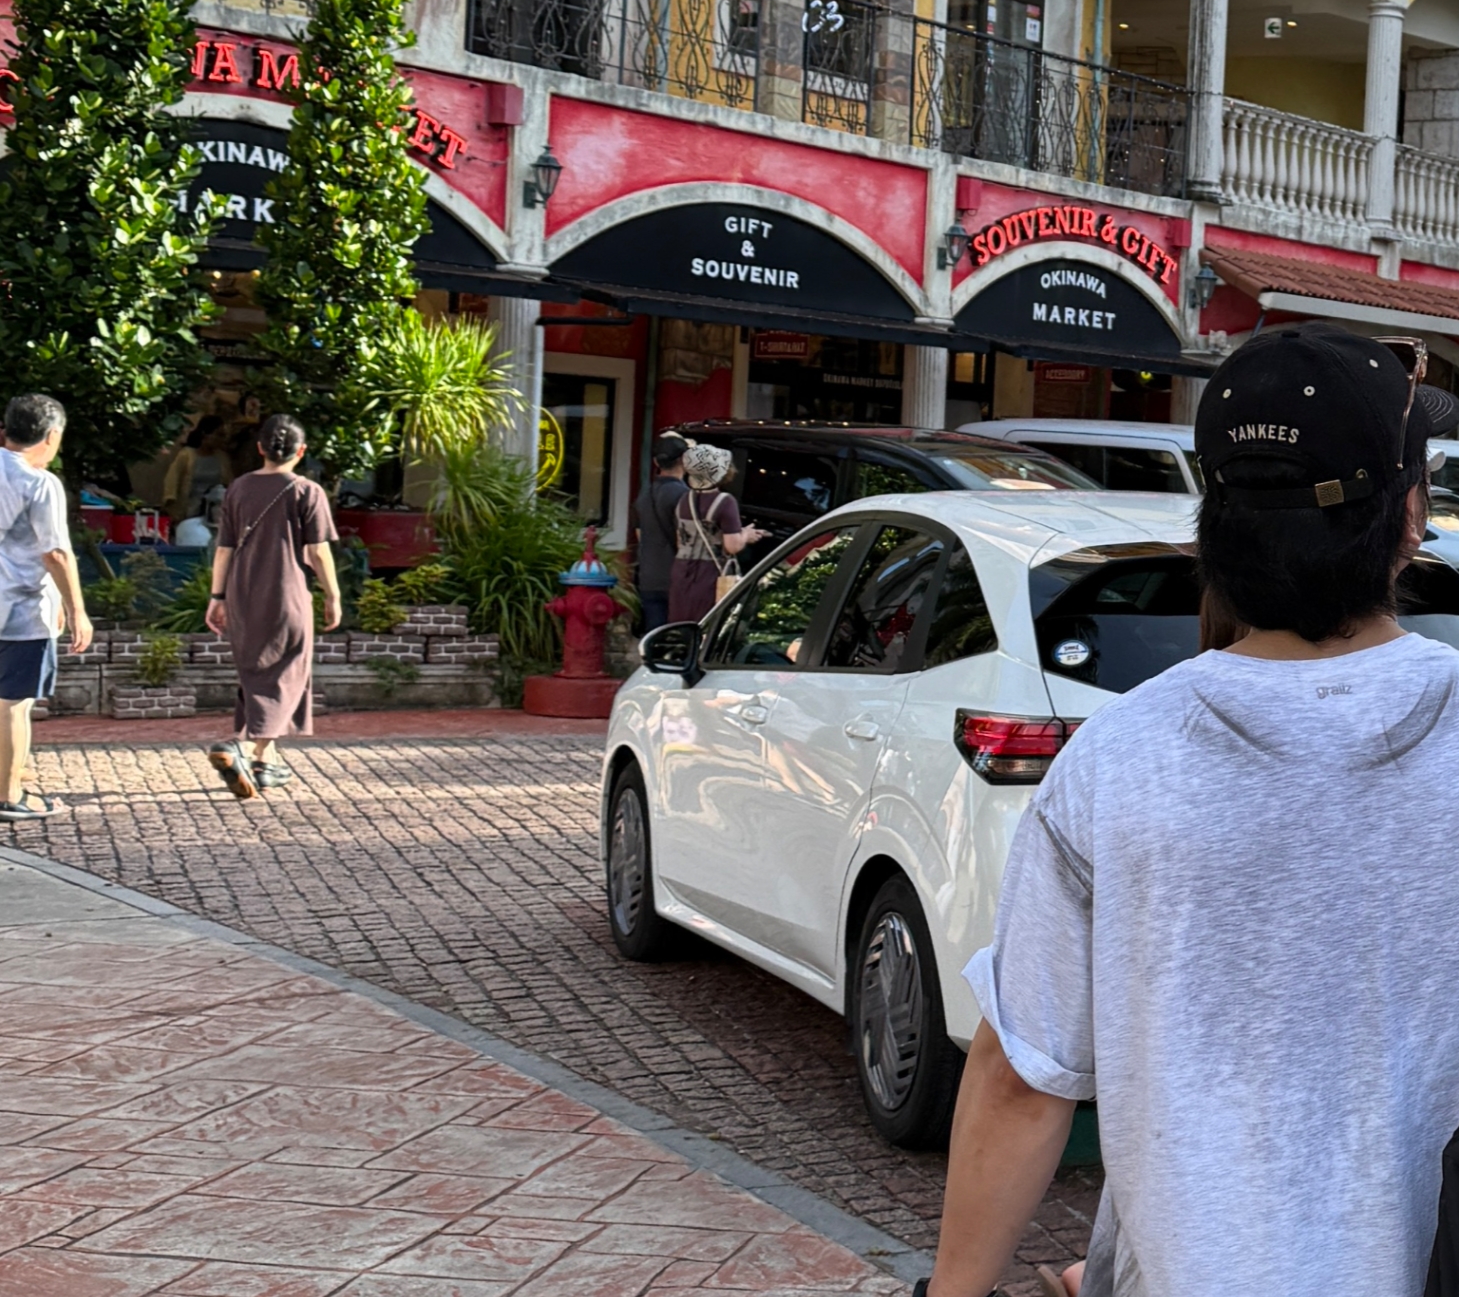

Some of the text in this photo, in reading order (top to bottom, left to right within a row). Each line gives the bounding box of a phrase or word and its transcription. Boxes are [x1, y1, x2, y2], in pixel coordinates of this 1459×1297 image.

[724, 215, 773, 239] GIFT
[741, 239, 756, 258] &
[972, 205, 1178, 284] SOUVENIR & GIFT
[691, 257, 800, 289] SOUVENIR
[1040, 269, 1107, 299] OKINAWA
[1032, 302, 1117, 330] MARKET
[1227, 424, 1300, 445] YANKEES
